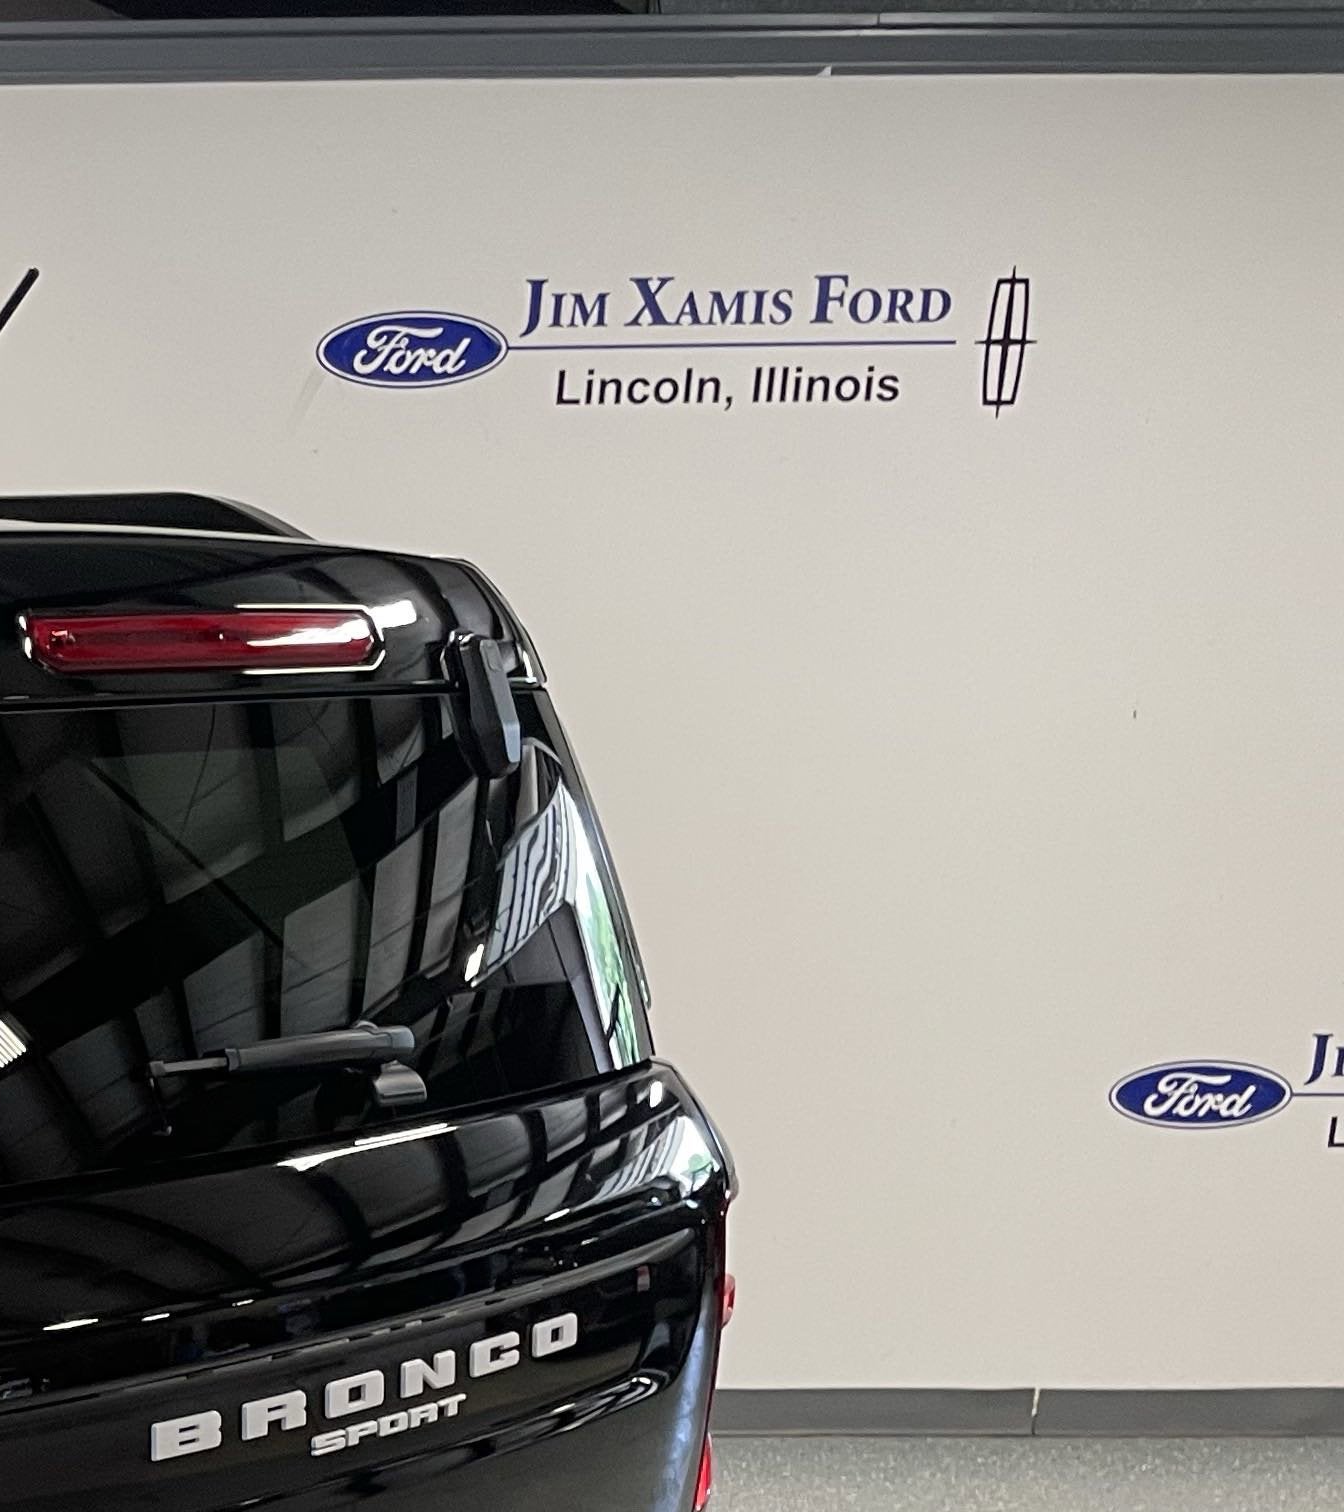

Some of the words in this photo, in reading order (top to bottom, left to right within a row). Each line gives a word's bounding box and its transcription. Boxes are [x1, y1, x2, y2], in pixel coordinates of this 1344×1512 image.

[519, 278, 609, 337] JIM
[623, 275, 794, 328] XAMIS
[808, 274, 952, 325] FORD
[352, 325, 471, 376] Ford
[554, 368, 733, 411] Lincoln,
[751, 366, 900, 404] Illinois
[1143, 1071, 1256, 1118] Ford
[151, 1312, 578, 1462] BRONCO
[311, 1392, 467, 1457] SPORT
